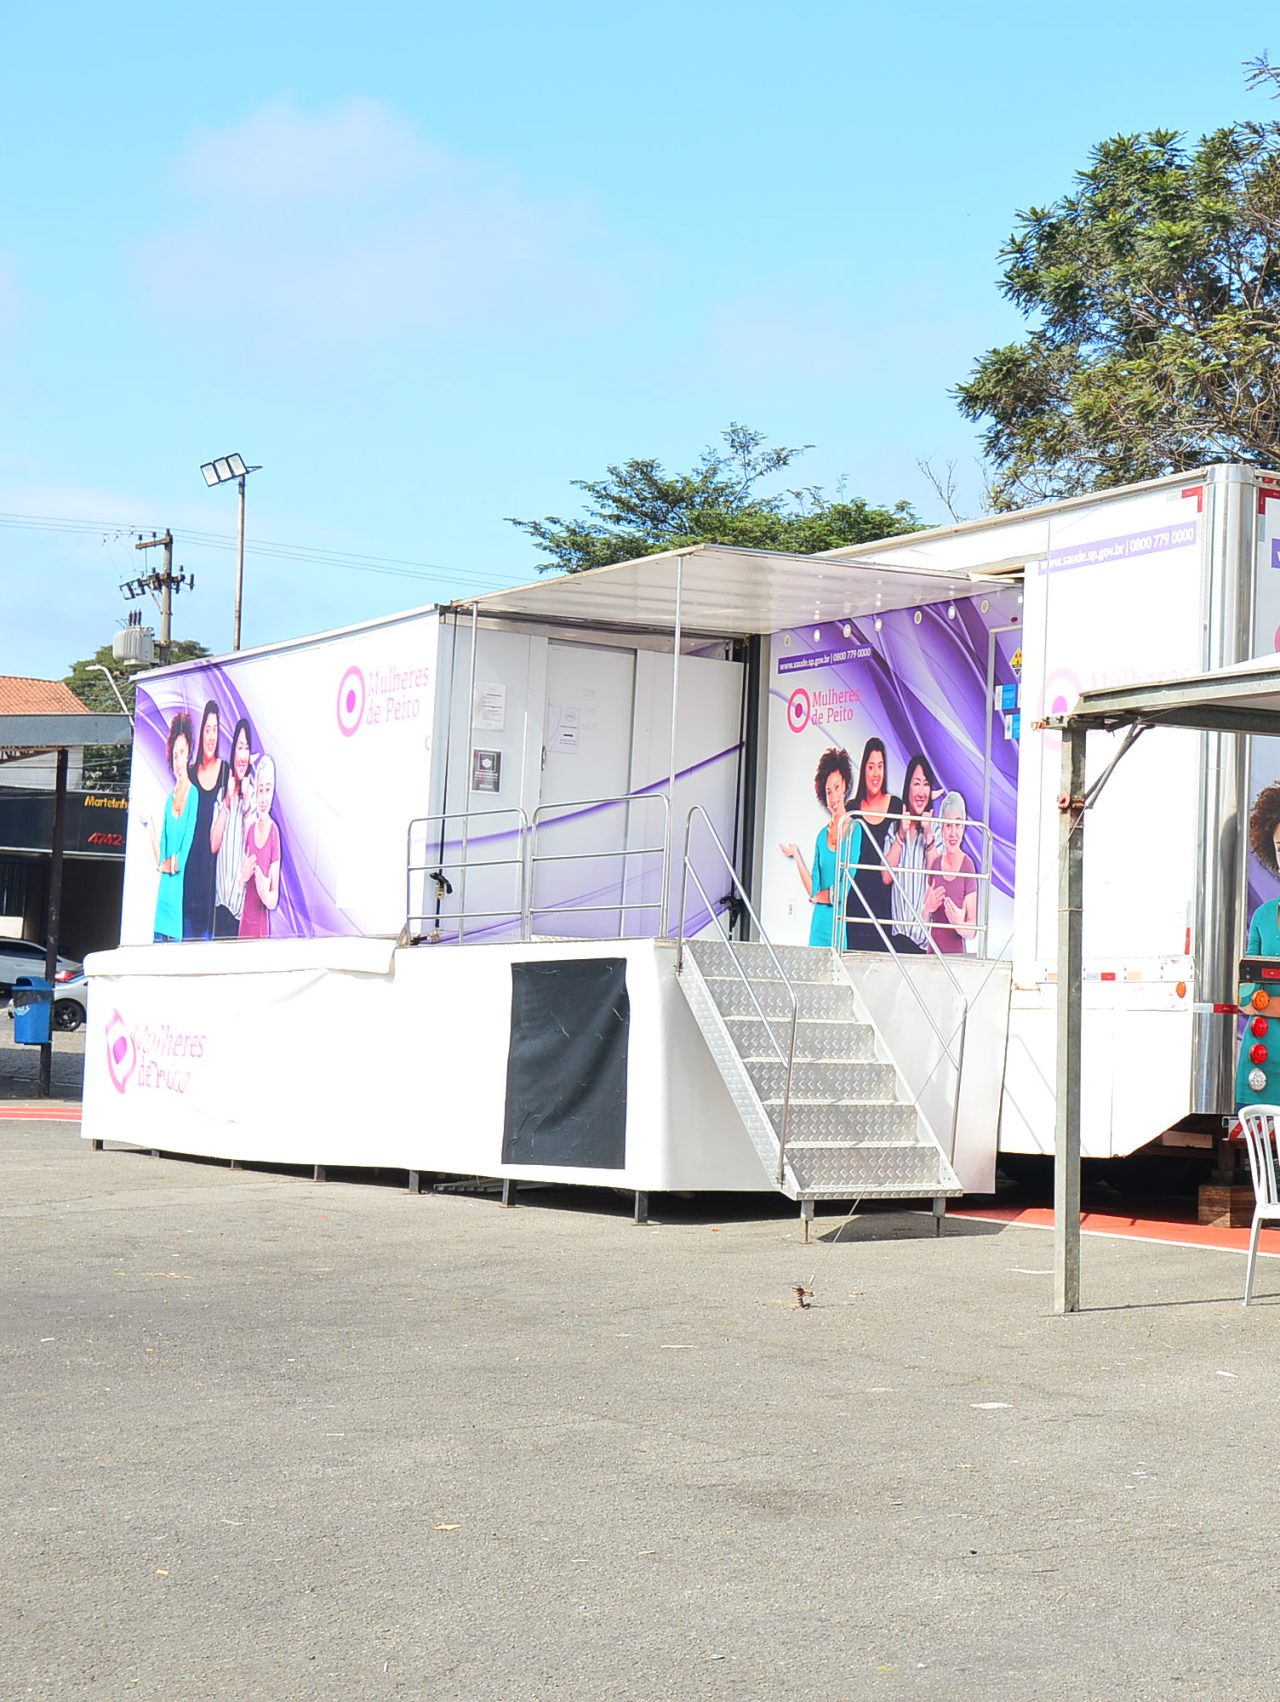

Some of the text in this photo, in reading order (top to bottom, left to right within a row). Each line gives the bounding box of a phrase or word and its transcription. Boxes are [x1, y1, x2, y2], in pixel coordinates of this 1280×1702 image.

[1040, 543, 1124, 570] www.saude.sp.gov.br
[1130, 536, 1152, 551] 0800
[1152, 532, 1169, 546] 779
[1171, 528, 1194, 544] 0000
[833, 651, 846, 662] 0800
[847, 649, 856, 659] 779
[857, 647, 871, 657] 0000
[812, 688, 860, 708] Mulheres
[366, 699, 381, 725] de
[811, 706, 854, 725] de Peito
